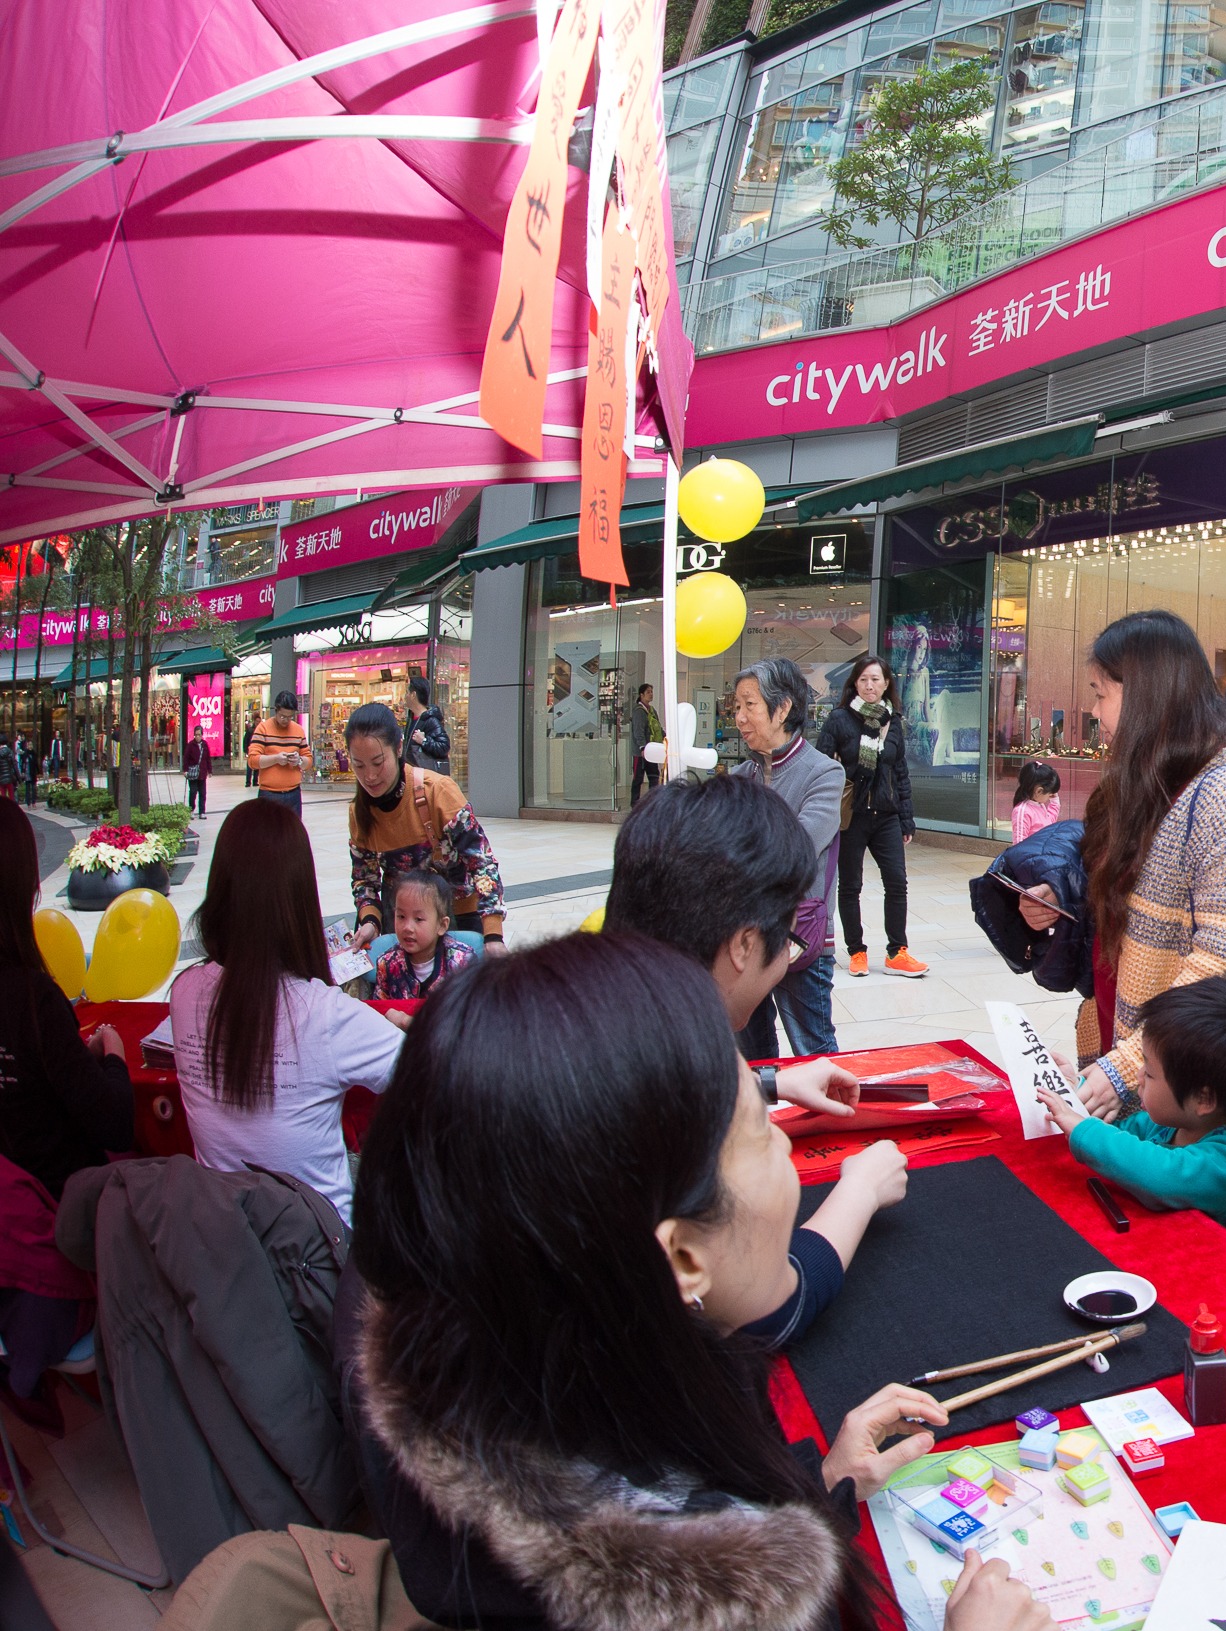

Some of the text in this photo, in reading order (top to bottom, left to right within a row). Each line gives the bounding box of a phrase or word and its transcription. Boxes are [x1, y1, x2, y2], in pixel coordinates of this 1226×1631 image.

[766, 325, 948, 414] citywalk
[968, 263, 1112, 357] 荃新天地
[294, 526, 342, 559] 荃新天地
[208, 594, 243, 614] 荃新天地
